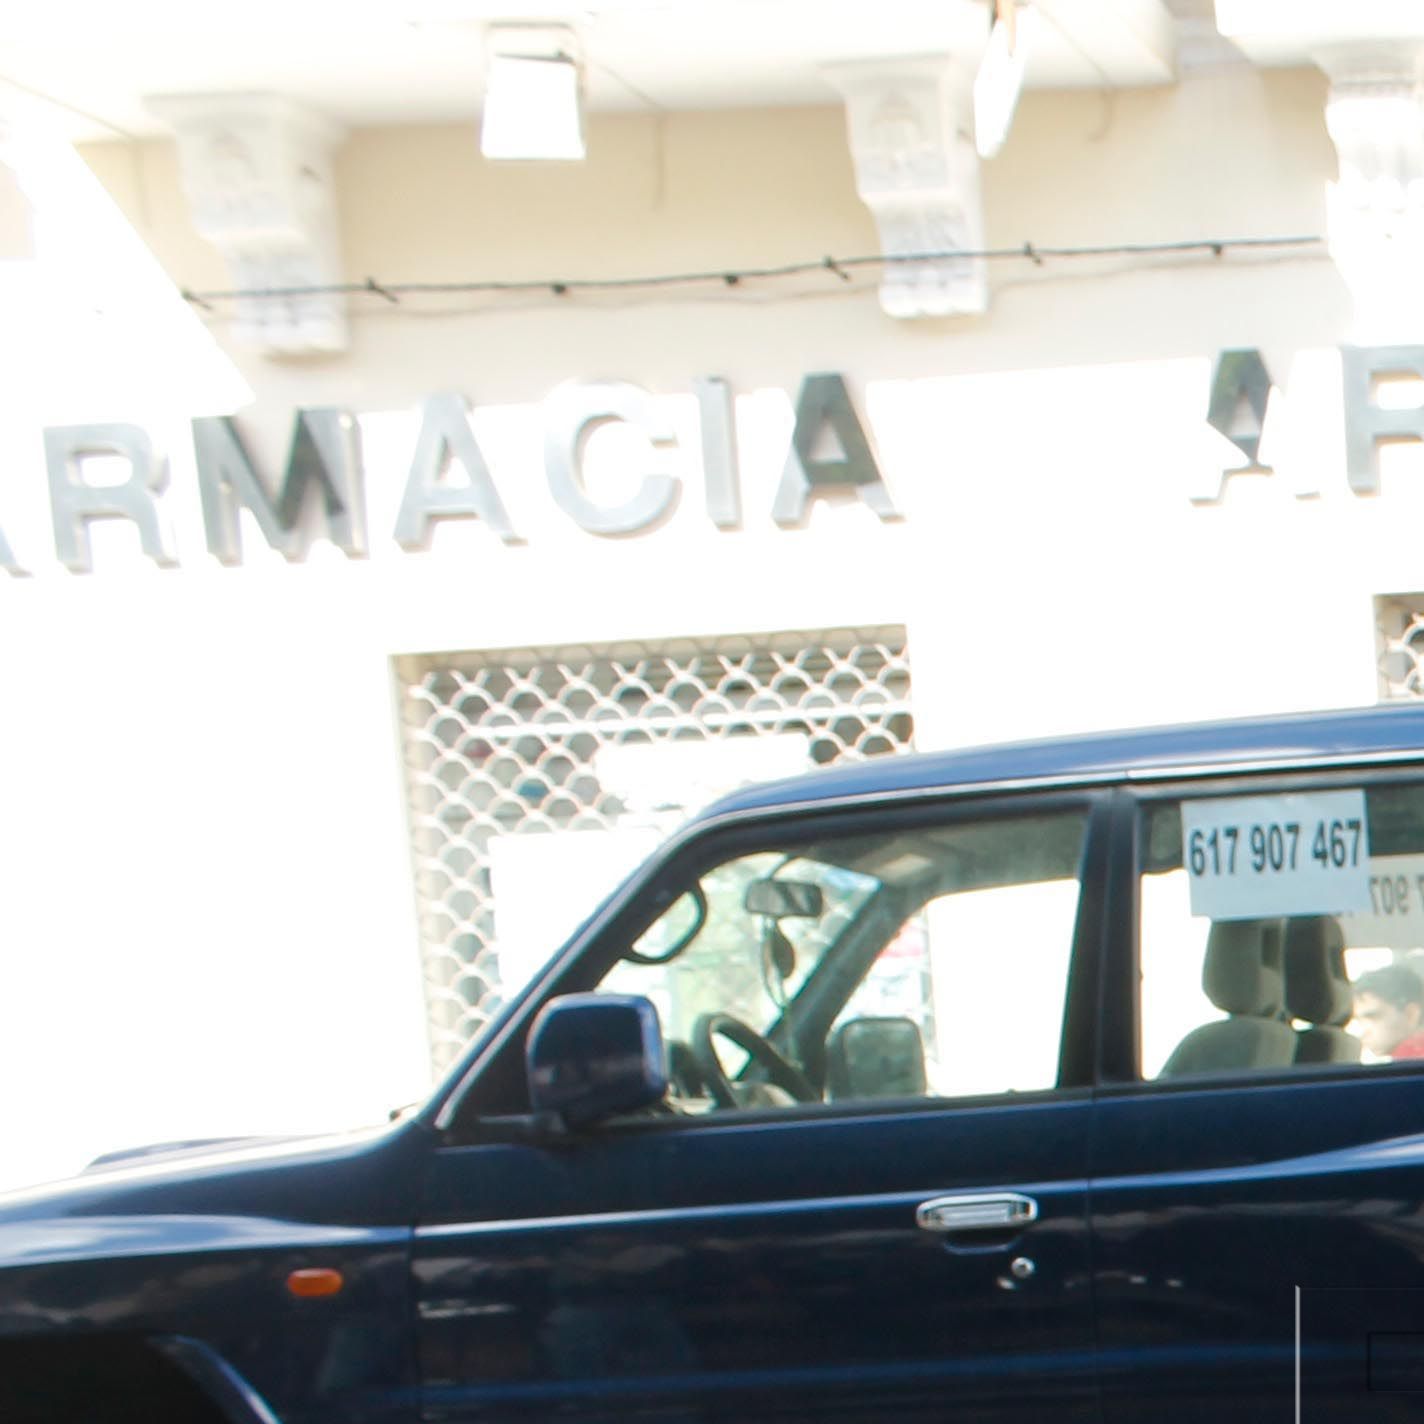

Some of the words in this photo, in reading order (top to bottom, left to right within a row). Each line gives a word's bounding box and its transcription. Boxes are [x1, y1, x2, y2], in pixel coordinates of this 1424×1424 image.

[0, 370, 907, 578] RMACIA
[1189, 825, 1238, 876] 617
[1250, 821, 1300, 872] 907
[1312, 817, 1362, 868] 467
